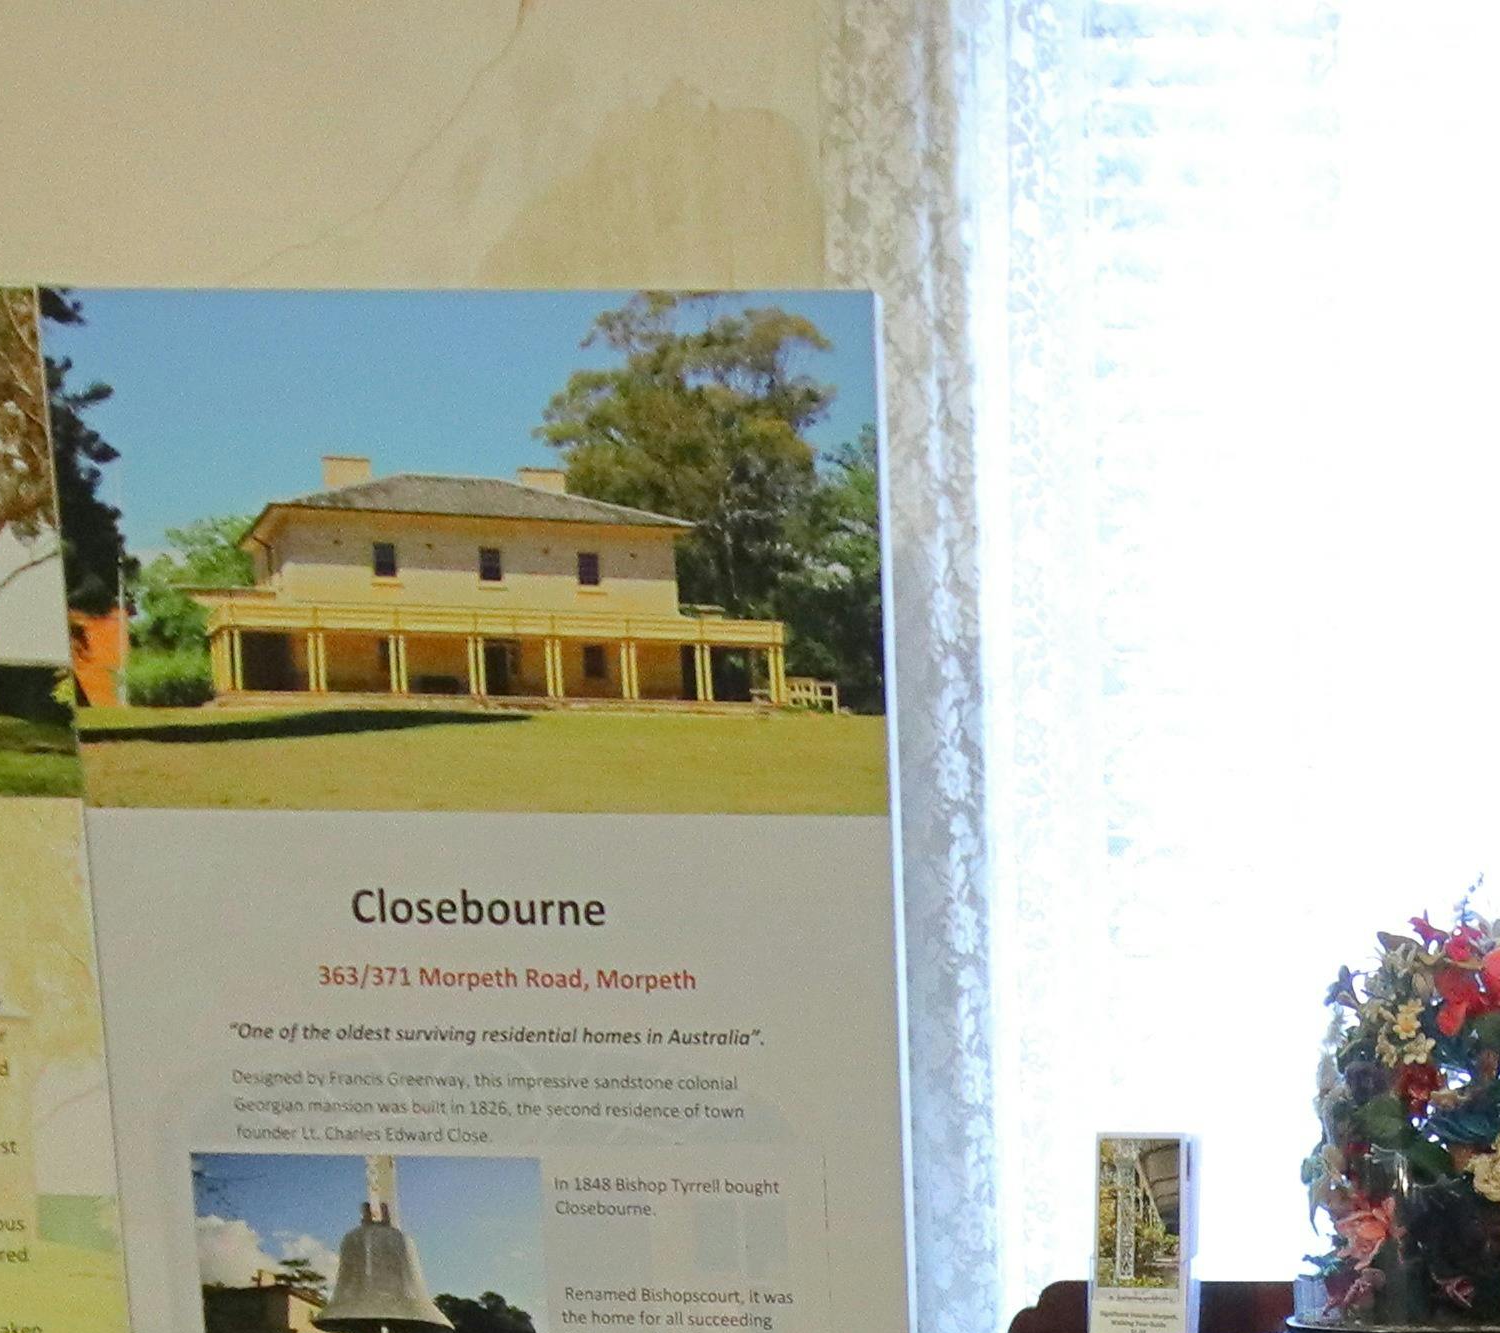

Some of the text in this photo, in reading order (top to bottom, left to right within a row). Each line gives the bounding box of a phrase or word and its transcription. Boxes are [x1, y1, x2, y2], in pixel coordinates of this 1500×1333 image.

[351, 888, 606, 928] Closebourne
[319, 964, 695, 993] 363/371 Morpeth Road, Morpeth
[279, 1023, 297, 1042] of
[303, 1024, 330, 1040] the
[336, 1024, 390, 1040] oldest
[396, 1026, 476, 1045] surviving
[482, 1026, 577, 1043] residential
[582, 1027, 641, 1044] homes
[647, 1028, 662, 1043] in
[554, 1178, 779, 1198] In 1848 Bishop Tyrrell bought
[555, 1200, 655, 1216] Closebourne.
